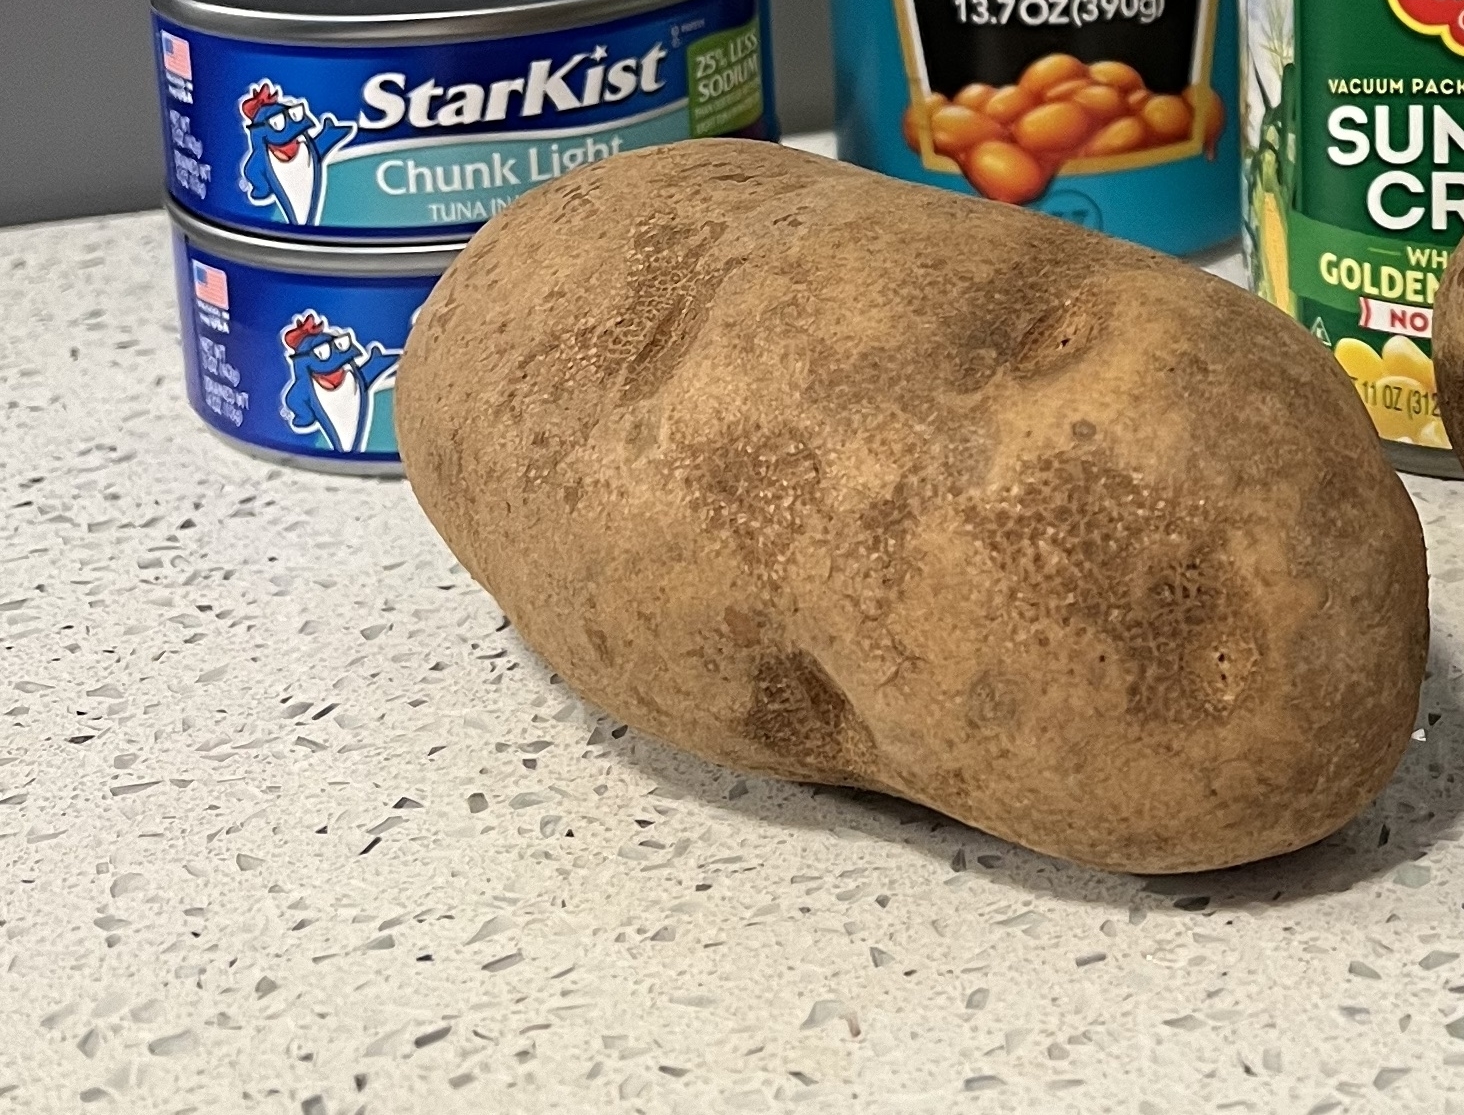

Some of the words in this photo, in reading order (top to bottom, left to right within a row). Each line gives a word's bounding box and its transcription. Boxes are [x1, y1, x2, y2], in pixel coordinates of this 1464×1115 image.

[696, 47, 728, 79] 25%
[729, 32, 758, 63] LESS
[359, 42, 668, 129] StarKist
[697, 53, 758, 103] SODIUM
[1328, 78, 1404, 95] VACUUM
[376, 153, 522, 196] Chunk
[429, 198, 487, 223] TUNA
[1319, 252, 1440, 304] GOLDEN
[1389, 308, 1429, 332] NO
[1363, 380, 1377, 406] 11
[1382, 385, 1403, 411] OZ
[1407, 389, 1440, 420] (312
